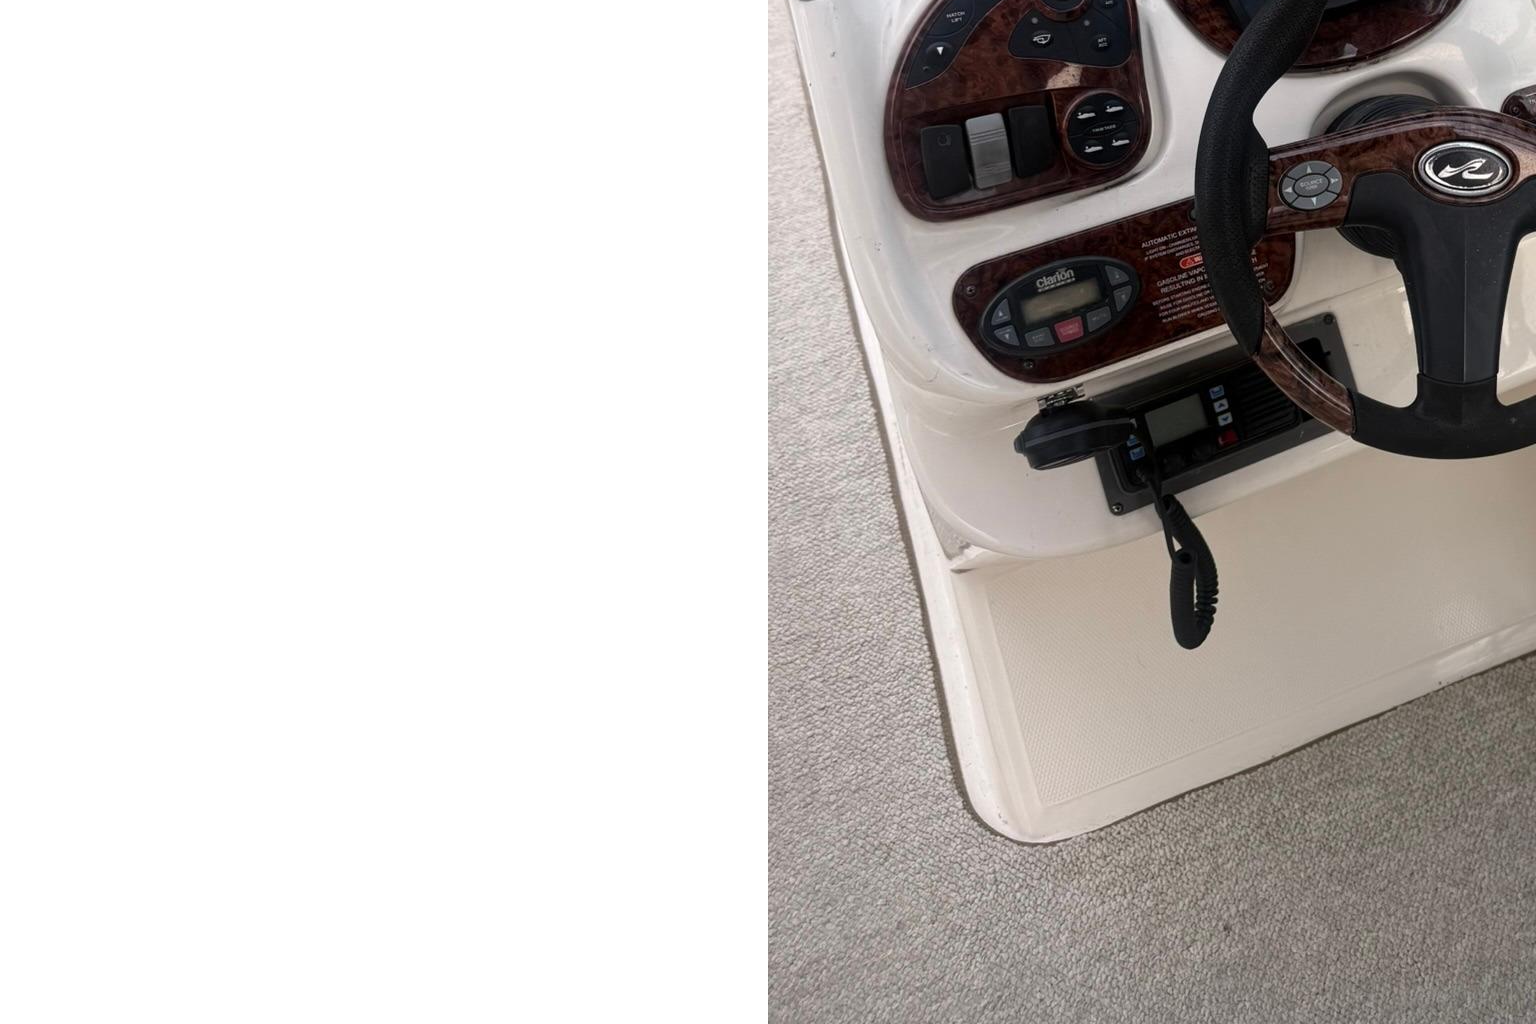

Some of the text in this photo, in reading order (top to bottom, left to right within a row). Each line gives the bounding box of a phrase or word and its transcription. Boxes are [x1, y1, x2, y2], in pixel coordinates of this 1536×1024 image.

[946, 11, 966, 19] HATCH
[1141, 232, 1176, 247] AUTOMATIC
[1036, 268, 1075, 288] clarion
[1157, 272, 1187, 287] GASOLINE
[1160, 277, 1195, 293] RESULTING
